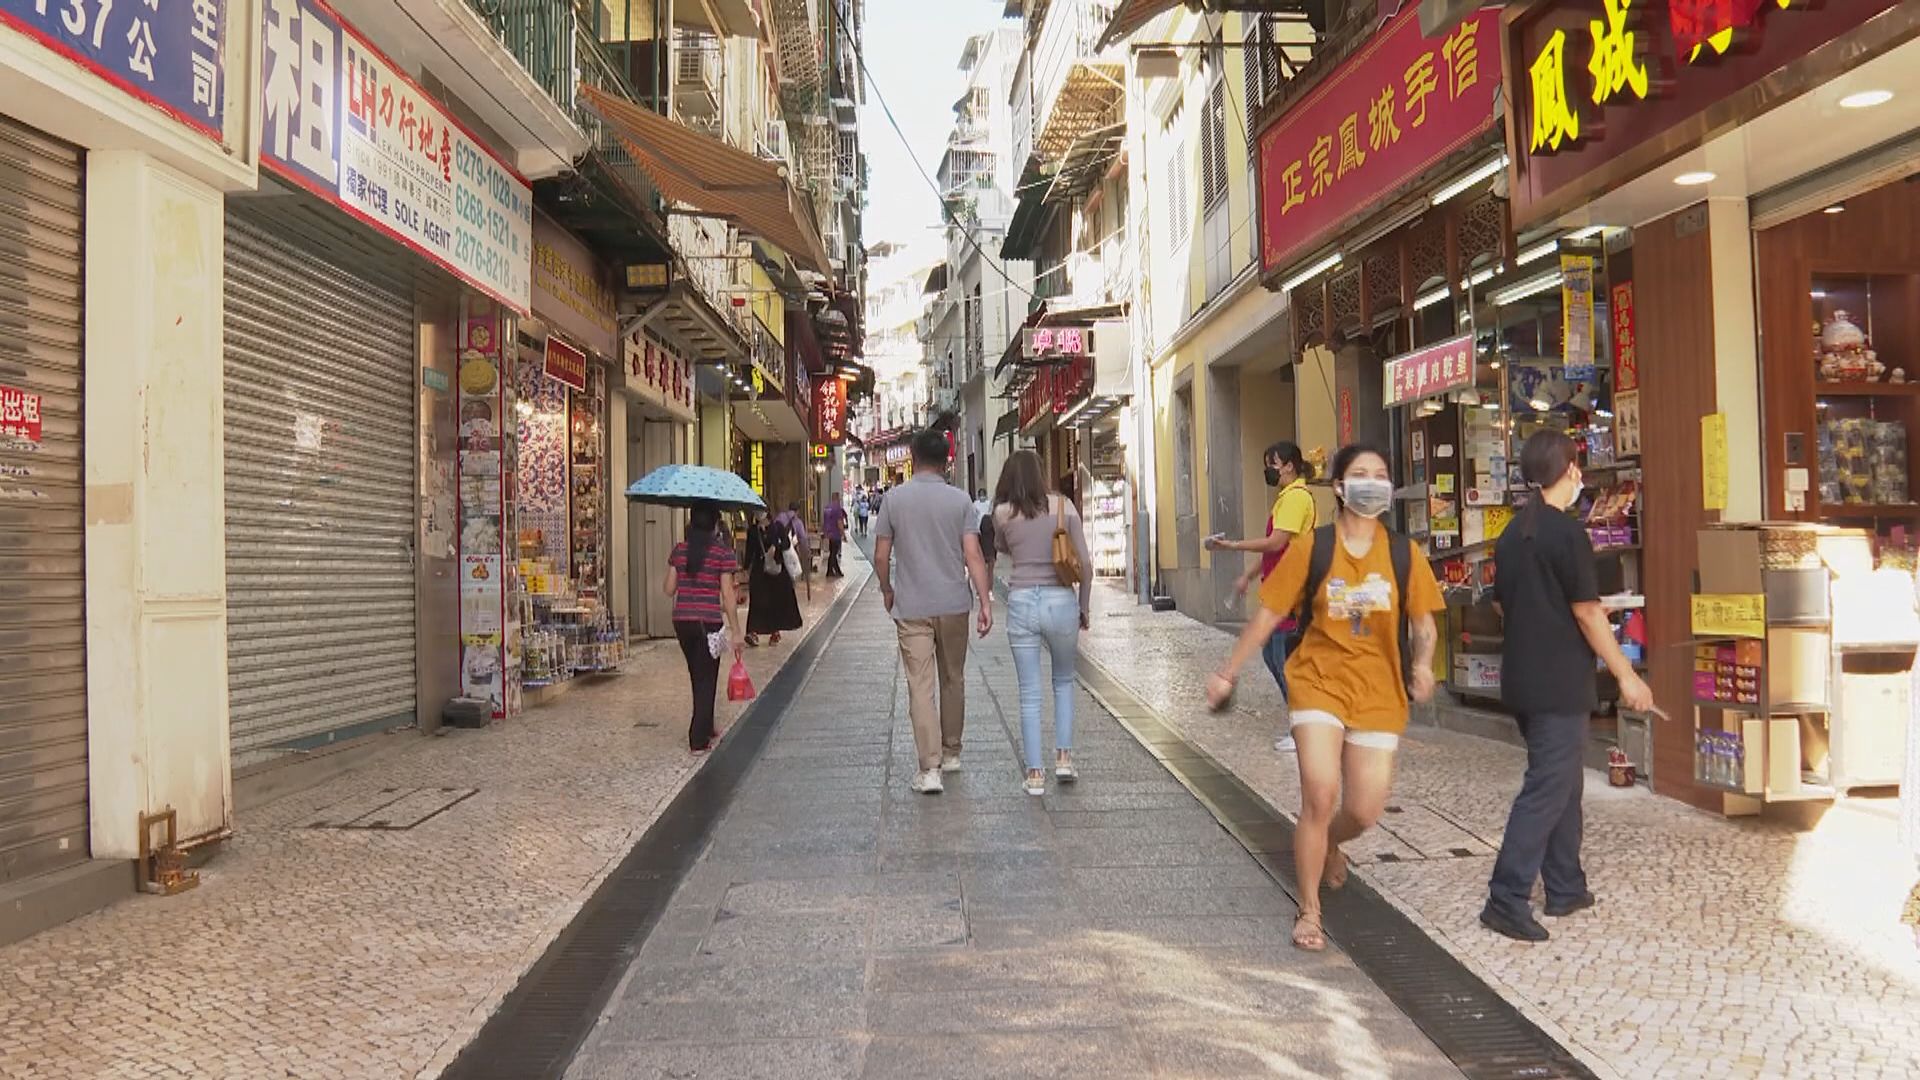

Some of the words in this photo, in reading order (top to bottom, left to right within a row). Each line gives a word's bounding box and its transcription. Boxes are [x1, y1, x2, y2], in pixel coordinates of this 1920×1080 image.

[127, 16, 157, 82] 公
[191, 50, 217, 117] 司
[265, 0, 338, 185] 租
[1281, 19, 1480, 216] 正宗鳳城手信
[416, 162, 451, 198] PROPERTY
[455, 139, 511, 209] 6279-1028
[395, 198, 419, 233] SOLE
[424, 218, 451, 252] AGENT
[455, 183, 510, 250] 6268-1521
[454, 226, 510, 289] 2876-8218
